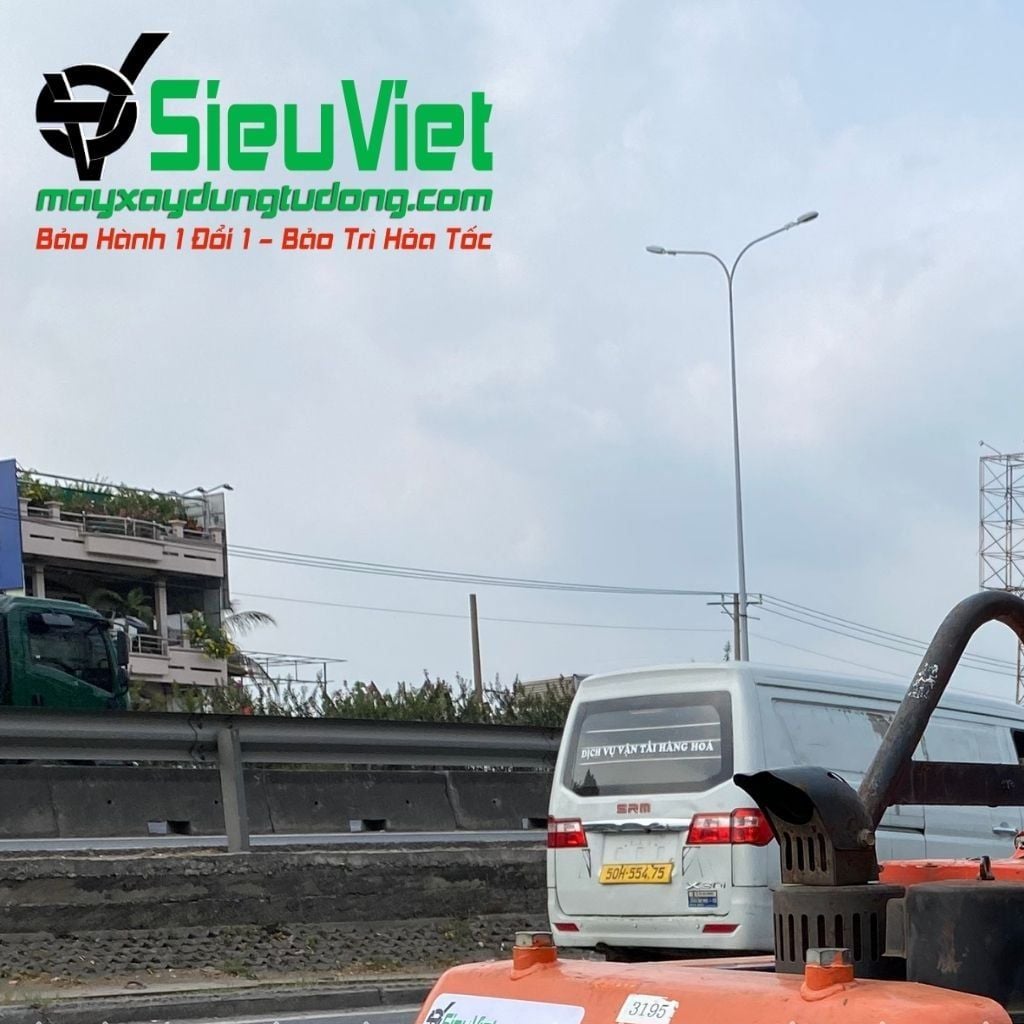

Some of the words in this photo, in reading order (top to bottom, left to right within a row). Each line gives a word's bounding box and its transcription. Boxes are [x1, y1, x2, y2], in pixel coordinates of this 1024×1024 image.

[581, 747, 601, 760] DỊCH
[603, 746, 616, 759] VỤ
[617, 743, 638, 758] VẬN
[640, 740, 657, 754] TẢI
[659, 741, 689, 754] HÀNG
[616, 803, 651, 815] SRM
[628, 1001, 670, 1019] 3195
